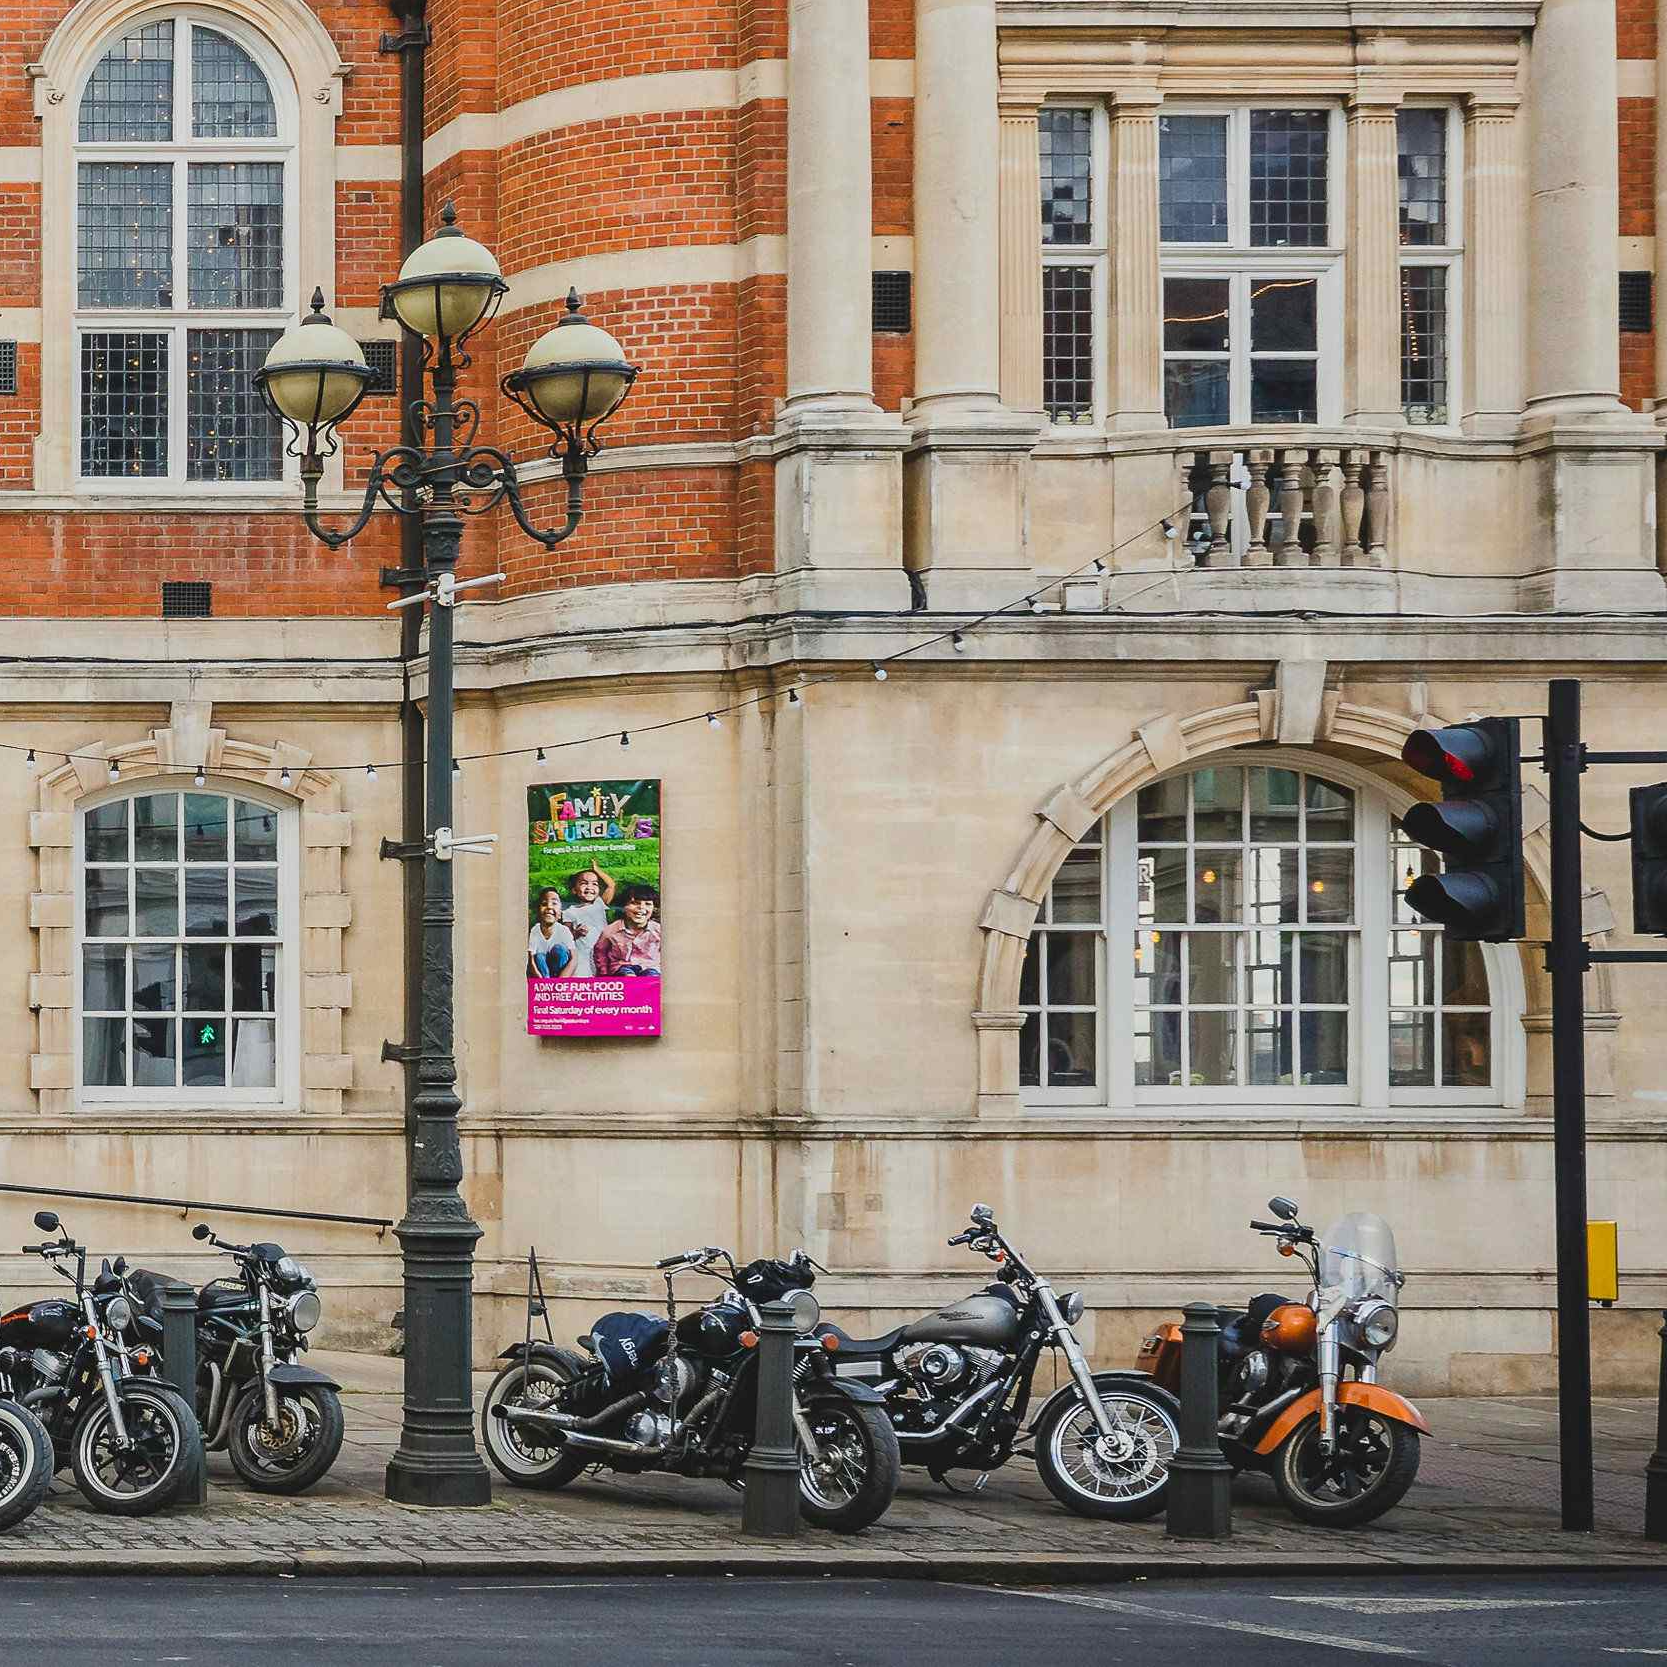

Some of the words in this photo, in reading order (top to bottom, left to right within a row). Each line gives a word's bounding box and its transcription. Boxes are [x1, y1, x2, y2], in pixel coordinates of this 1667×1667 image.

[555, 982, 569, 991] OF
[594, 981, 624, 991] FOOD
[534, 992, 551, 1002] AND
[552, 992, 571, 1002] FREE
[572, 991, 625, 1002] ACTIVITIES
[549, 1005, 583, 1016] Saturday
[584, 1005, 595, 1014] of
[595, 1006, 620, 1016] every
[620, 1005, 653, 1014] month
